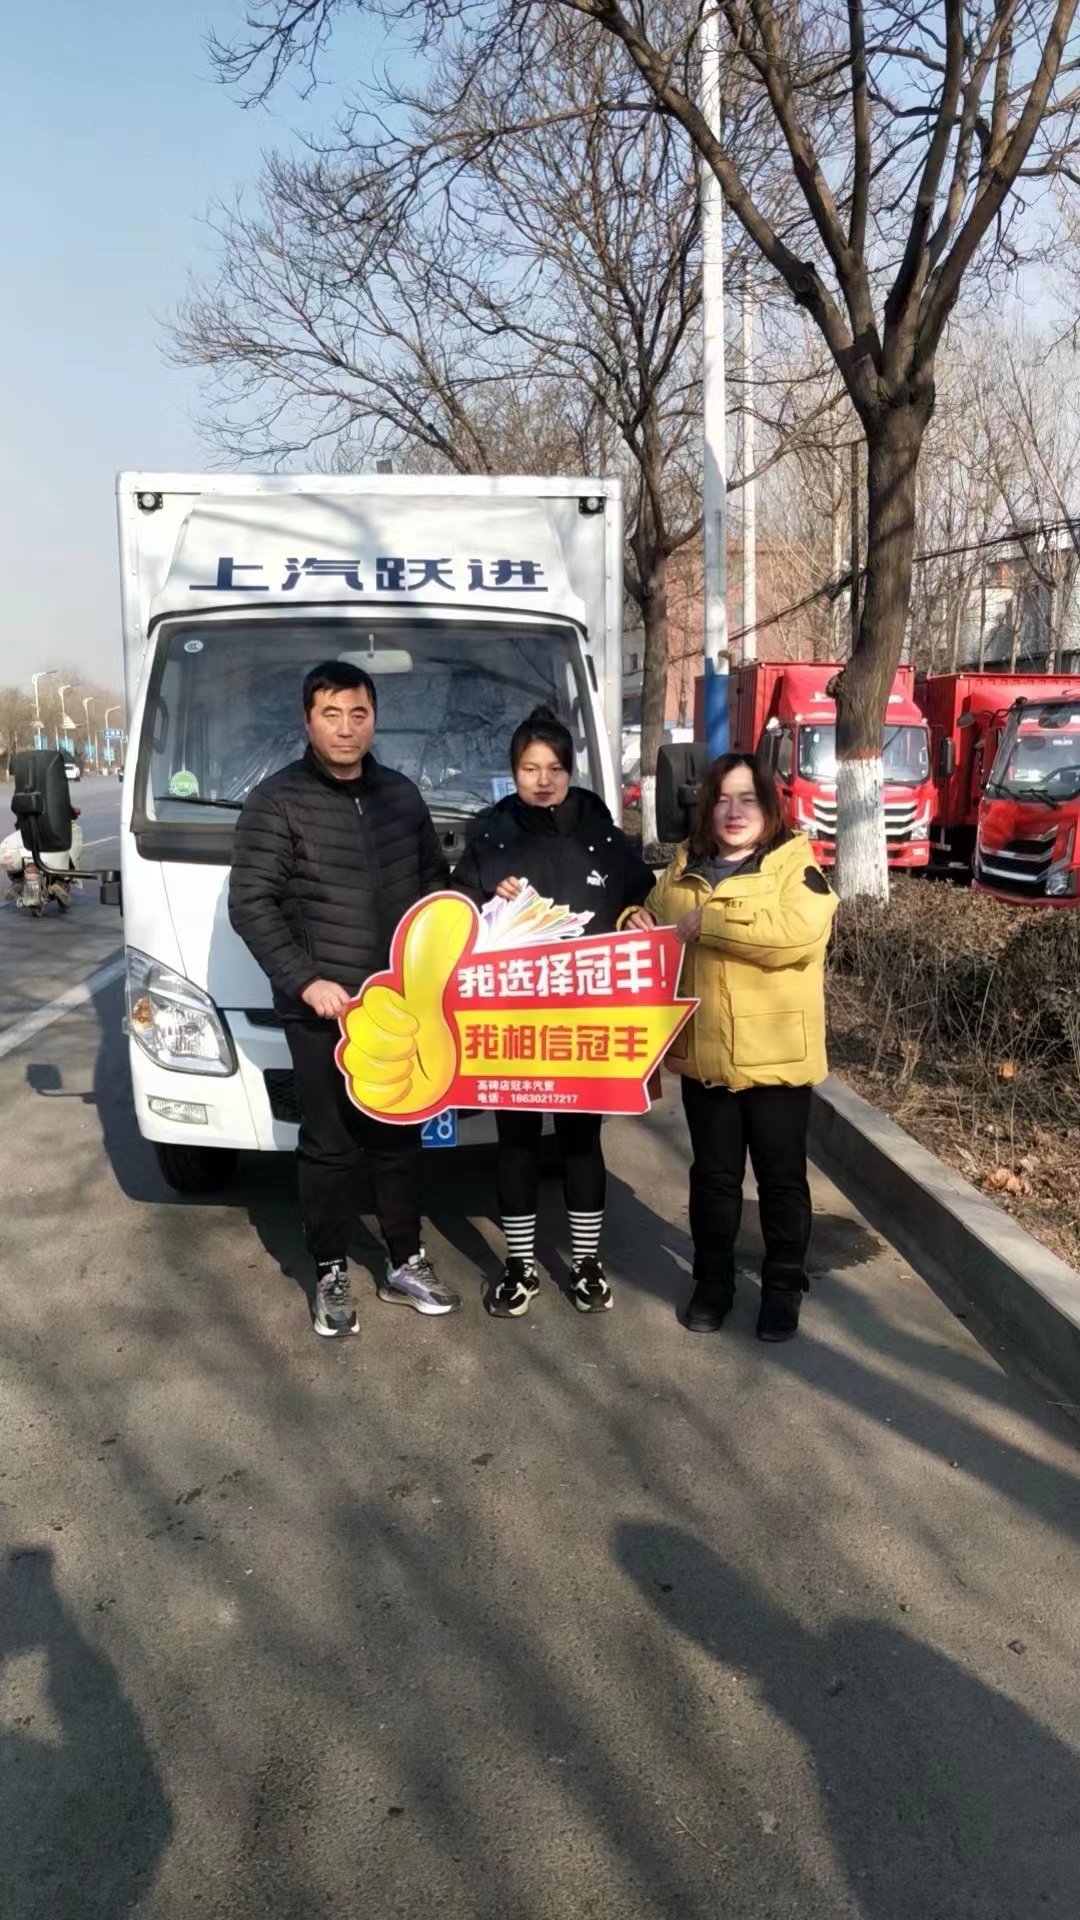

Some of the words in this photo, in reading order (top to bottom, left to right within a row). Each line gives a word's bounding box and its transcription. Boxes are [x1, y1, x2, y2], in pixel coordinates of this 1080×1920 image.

[189, 557, 549, 592] 上汽跃进
[457, 941, 667, 998] 我选择冠丰!
[465, 1024, 648, 1061] 我相信冠丰
